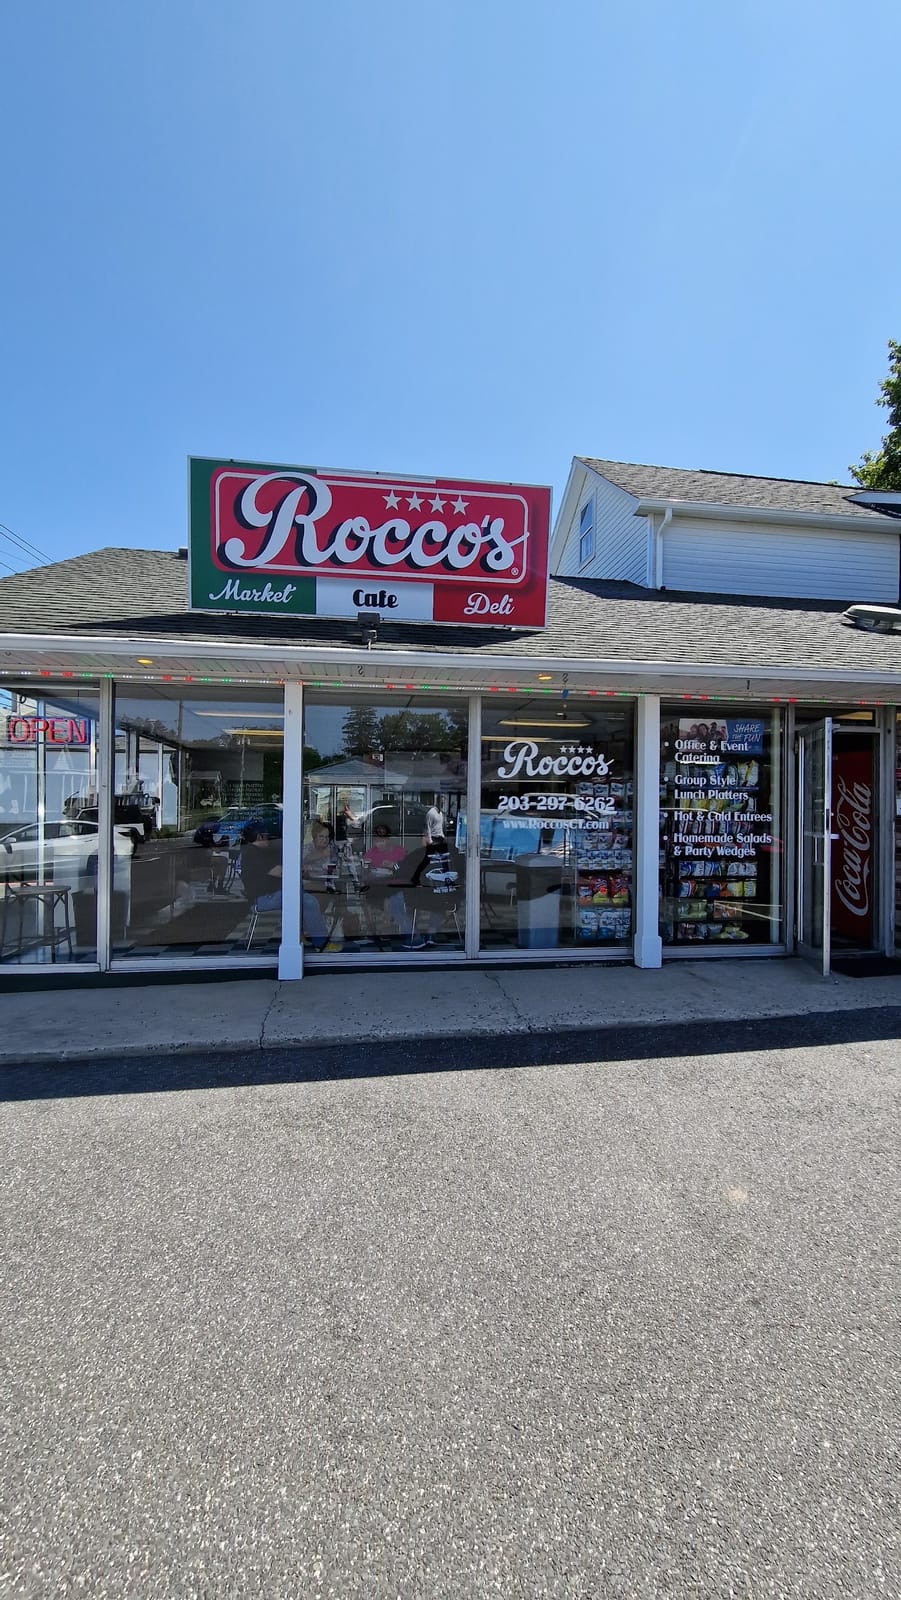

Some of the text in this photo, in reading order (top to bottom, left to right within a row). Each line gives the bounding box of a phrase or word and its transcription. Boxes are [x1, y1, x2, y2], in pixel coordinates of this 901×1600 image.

[219, 472, 530, 572] Rocco's
[209, 579, 296, 605] Market
[353, 589, 399, 609] Cafe
[464, 593, 515, 616] Deli
[8, 717, 86, 743] OPEN
[733, 723, 761, 734] SHARE
[743, 734, 761, 743] FUN
[674, 739, 749, 751] Office & Event
[674, 752, 720, 764] Catering
[674, 774, 736, 787] Group Style
[674, 790, 749, 801] Lunch Platters
[674, 811, 773, 822] Hot & Cold Entrees
[673, 832, 772, 844] Homemade Salads
[673, 846, 756, 858] & Party Wedges
[835, 775, 873, 917] Coca-Cola
